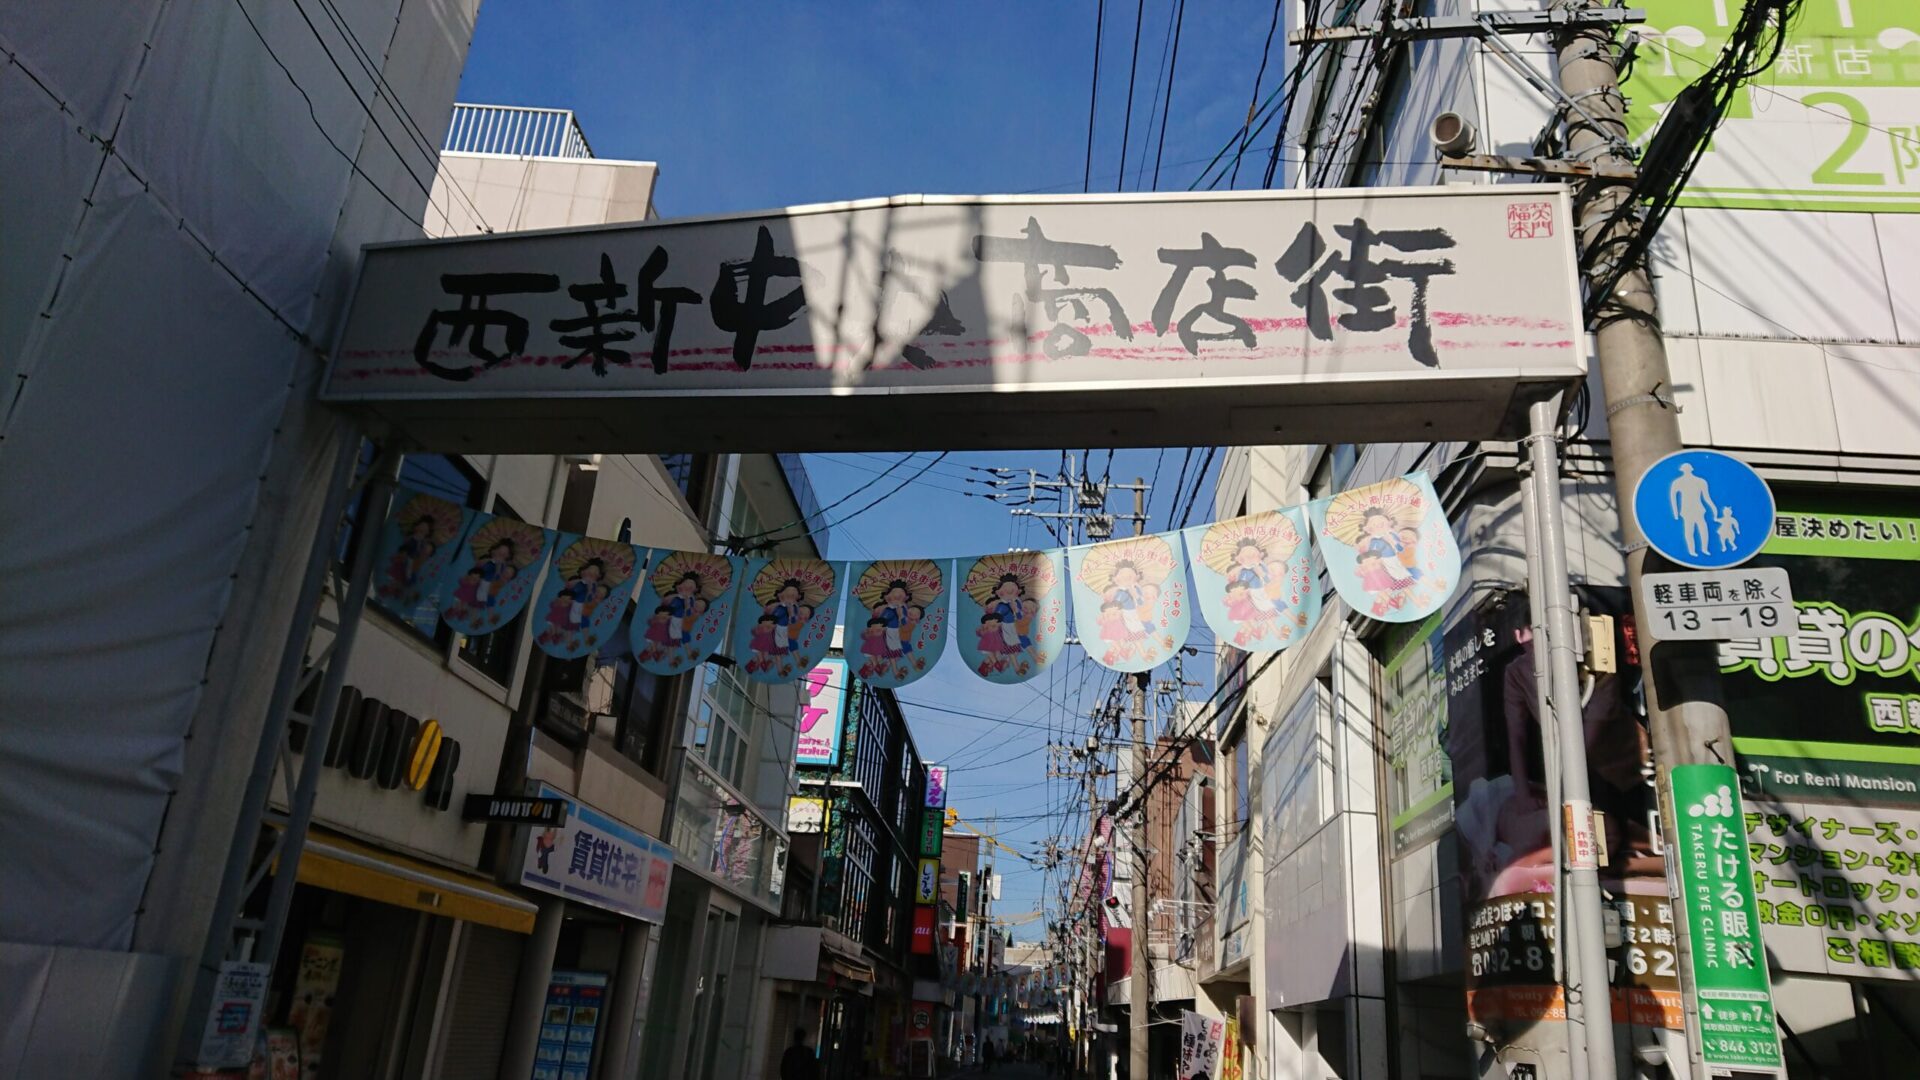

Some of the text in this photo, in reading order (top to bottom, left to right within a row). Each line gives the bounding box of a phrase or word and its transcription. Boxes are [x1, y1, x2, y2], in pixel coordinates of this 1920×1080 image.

[1719, 43, 1872, 75] 新店
[1654, 579, 1784, 604] 軽車両を除く
[1775, 770, 1917, 793] For Rent Mansion
[489, 800, 552, 819] DOUTOR
[568, 830, 638, 895] 賃貸住宅
[1749, 842, 1920, 877] マンション・分
[1691, 823, 1719, 968] TAKERU EYE CLINIC
[1710, 823, 1754, 970] たける眼科
[915, 927, 930, 935] au
[1483, 945, 1556, 975] 092-8
[1720, 1040, 1778, 1056] 846 3121
